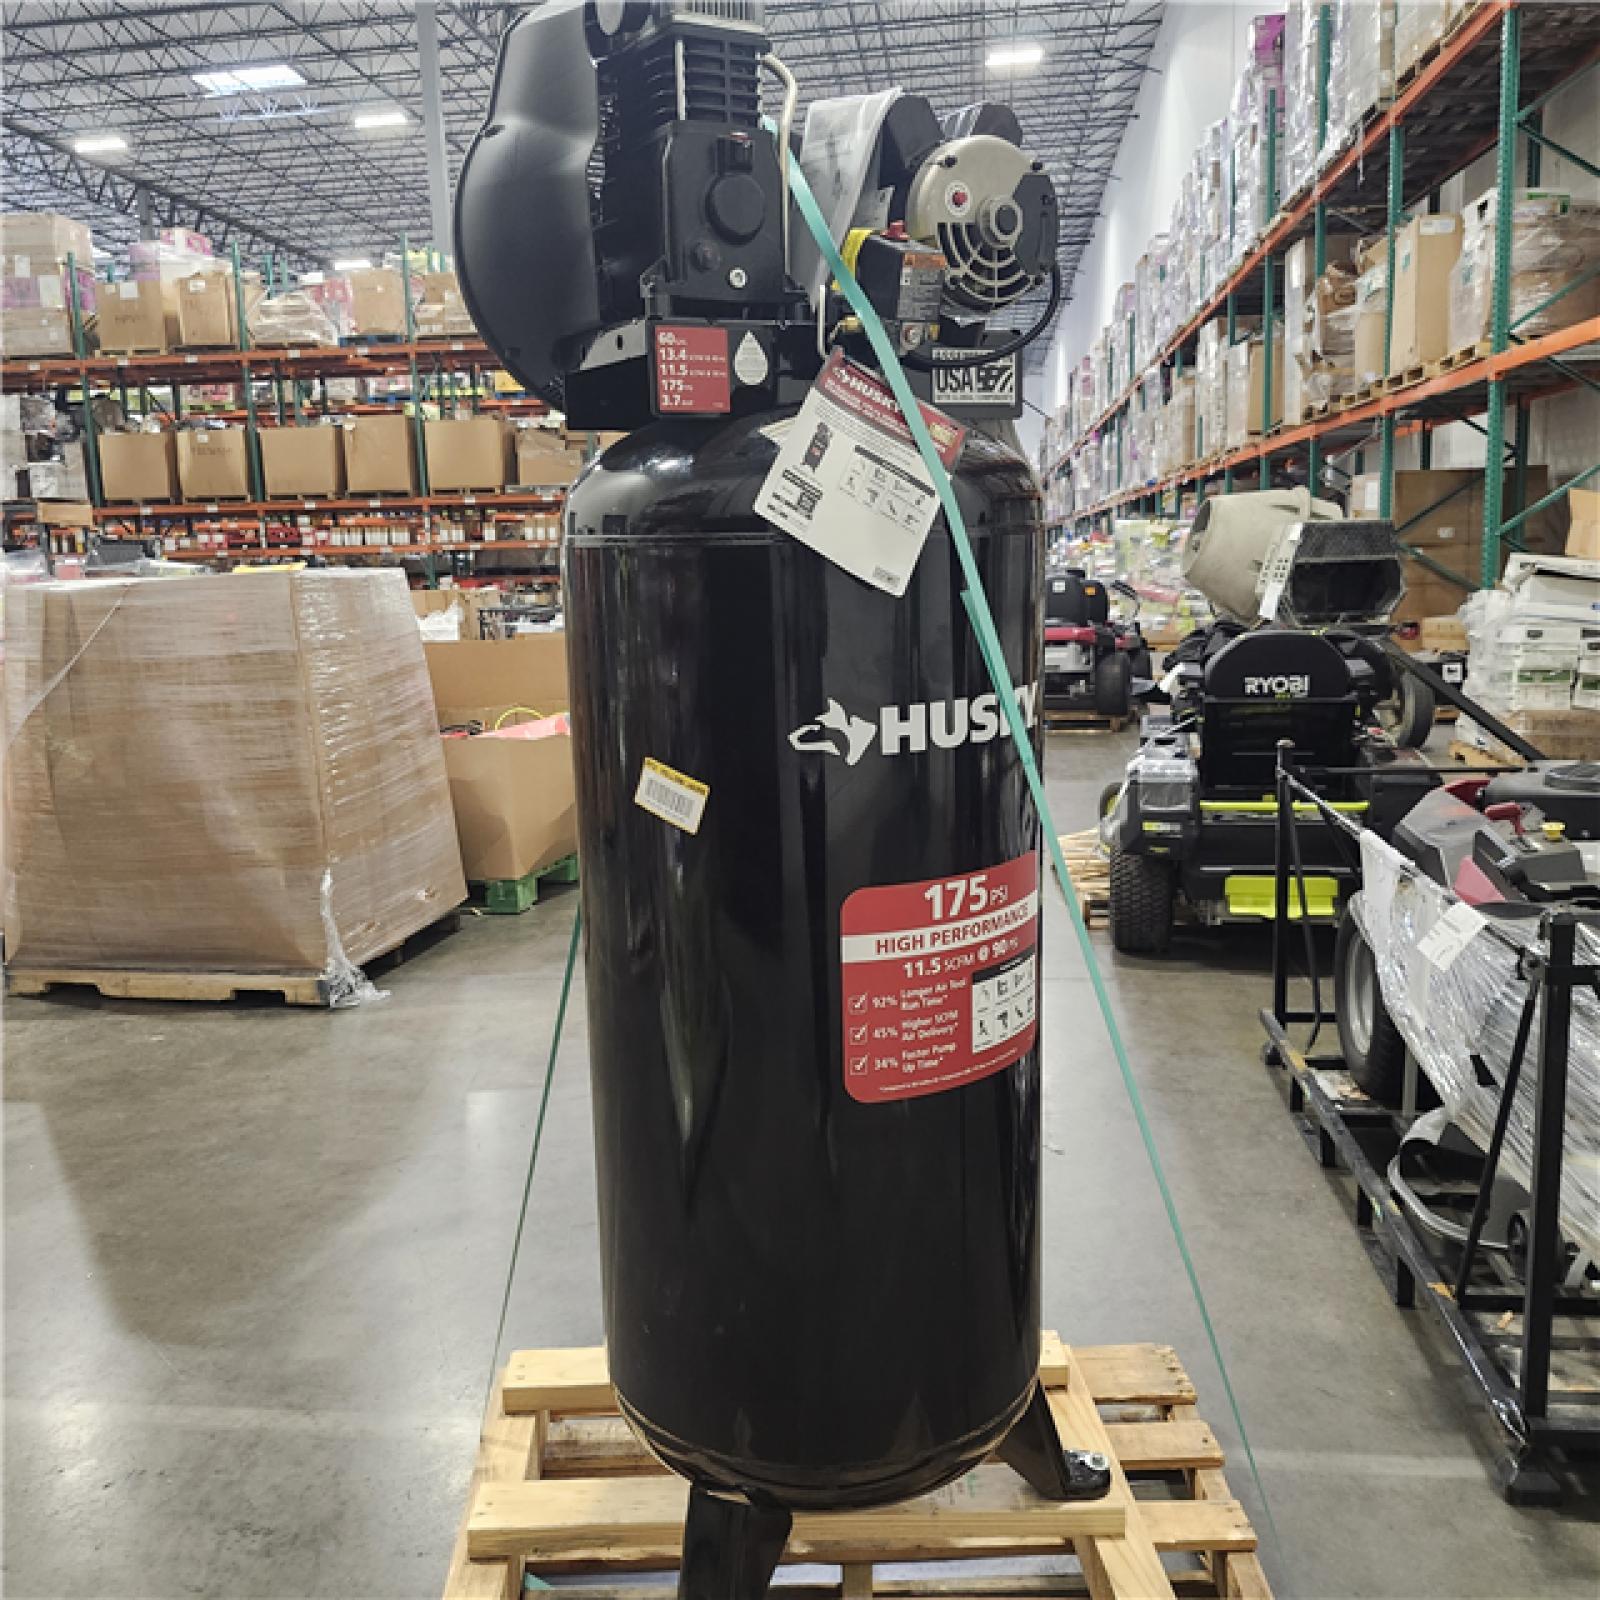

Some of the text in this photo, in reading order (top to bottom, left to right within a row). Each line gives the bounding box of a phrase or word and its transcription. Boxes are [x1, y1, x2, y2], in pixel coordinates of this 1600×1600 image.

[937, 366, 972, 392] USA
[1244, 674, 1311, 698] RYOBI
[924, 874, 1008, 920] 175 PSI
[875, 902, 1028, 955] HIGH PERFORMANCE
[904, 957, 941, 978] 11.5
